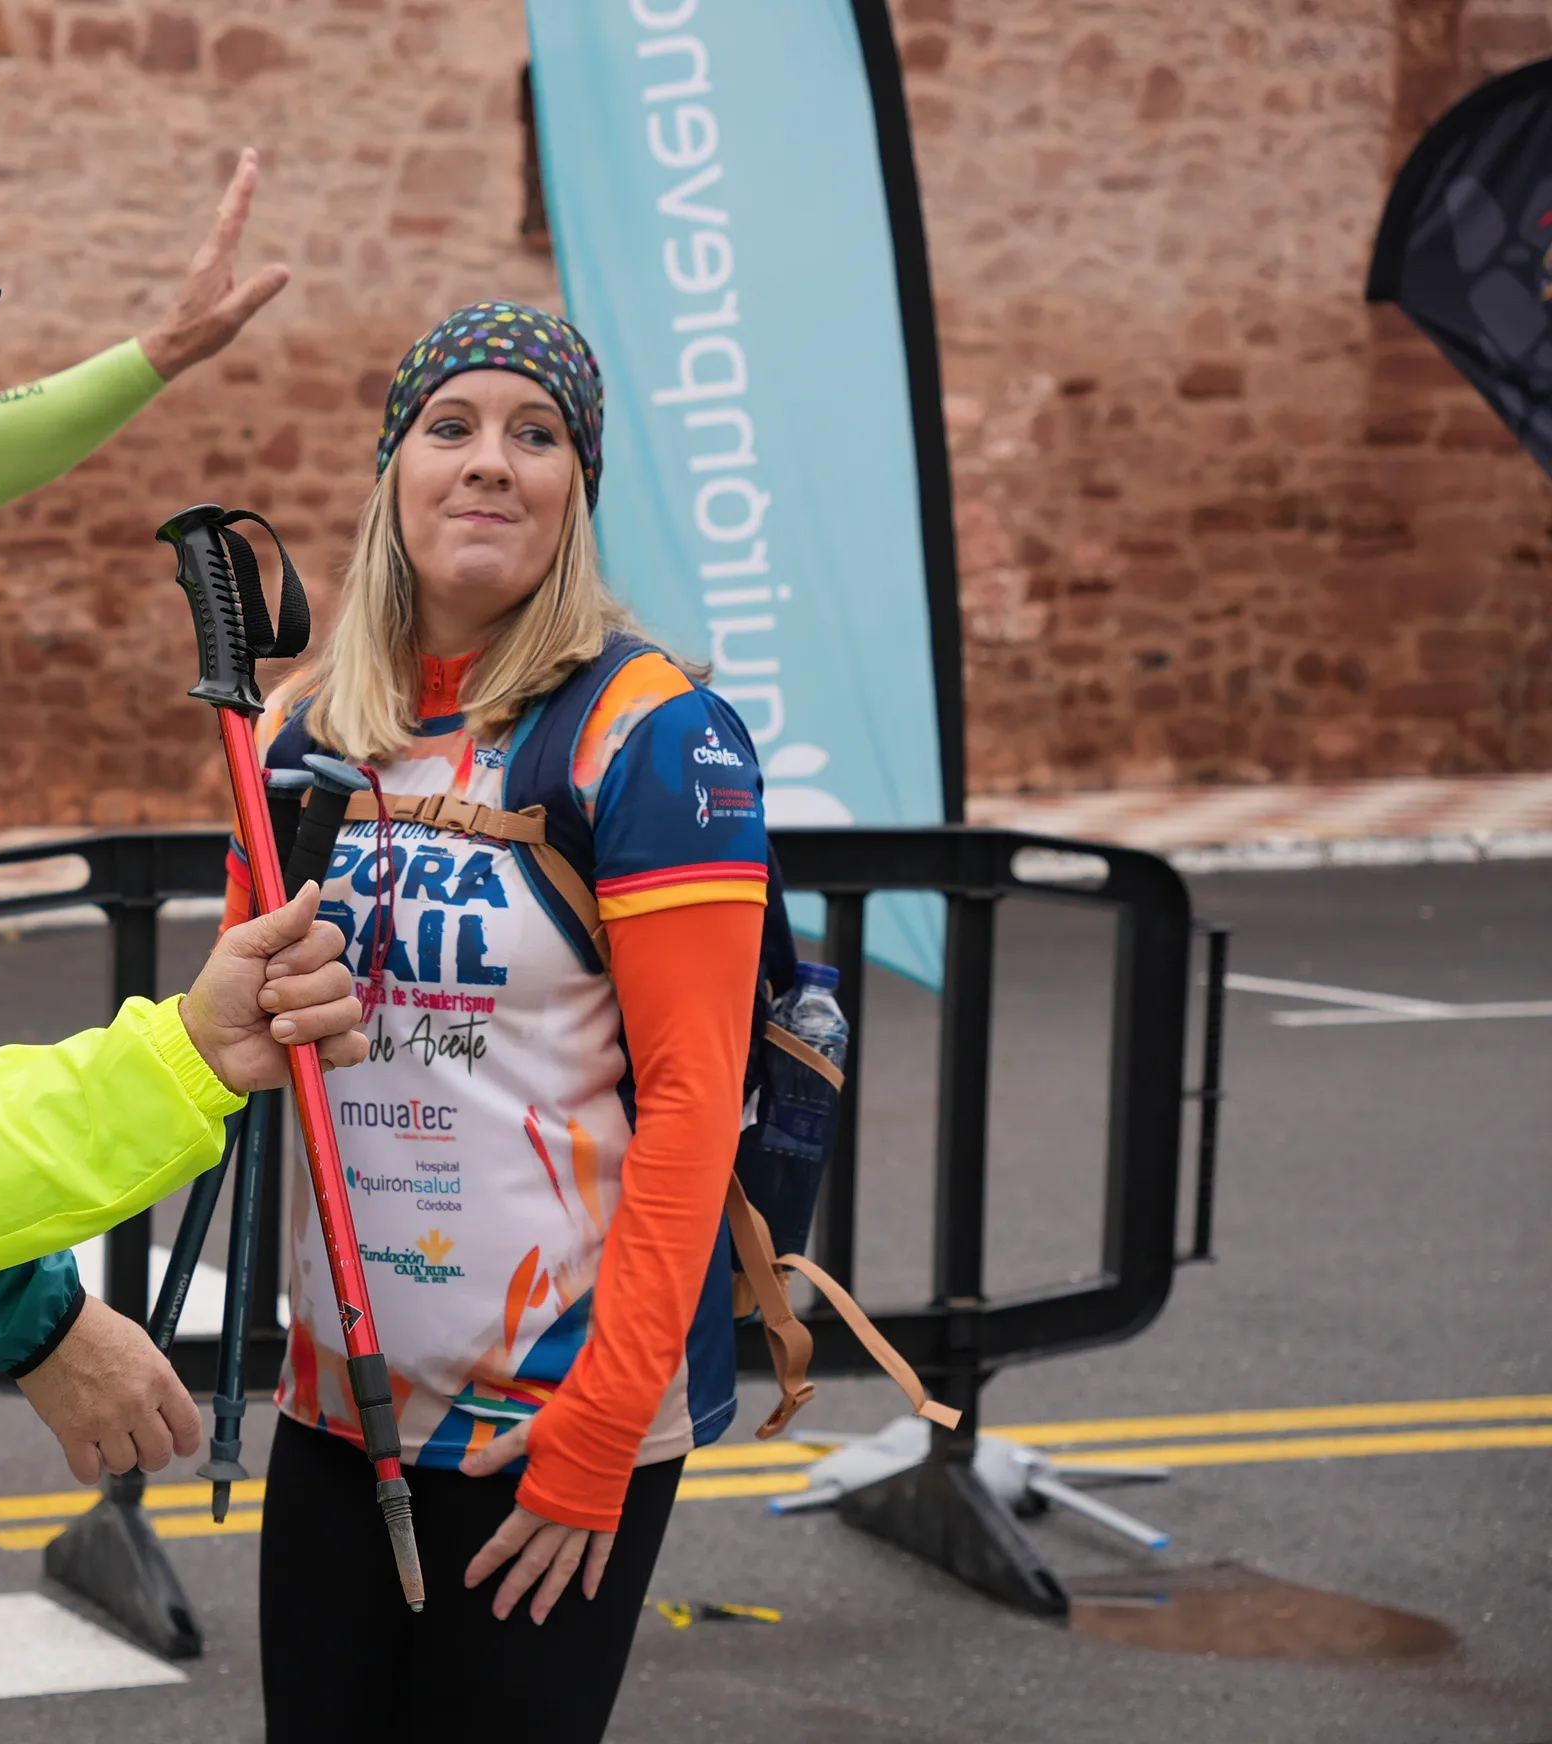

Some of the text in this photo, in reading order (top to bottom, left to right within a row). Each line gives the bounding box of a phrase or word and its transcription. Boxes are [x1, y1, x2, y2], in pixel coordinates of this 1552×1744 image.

[392, 985, 406, 1006] de
[411, 987, 496, 1014] Senderismo
[369, 1011, 489, 1077] de Aceite
[415, 1160, 460, 1174] Hospital
[360, 1174, 461, 1195] quirónsalud
[416, 1199, 462, 1212] Córdoba
[359, 1244, 425, 1267] Fundación
[423, 1265, 465, 1277] RURAL
[168, 1273, 190, 1320] FORCLAZ
